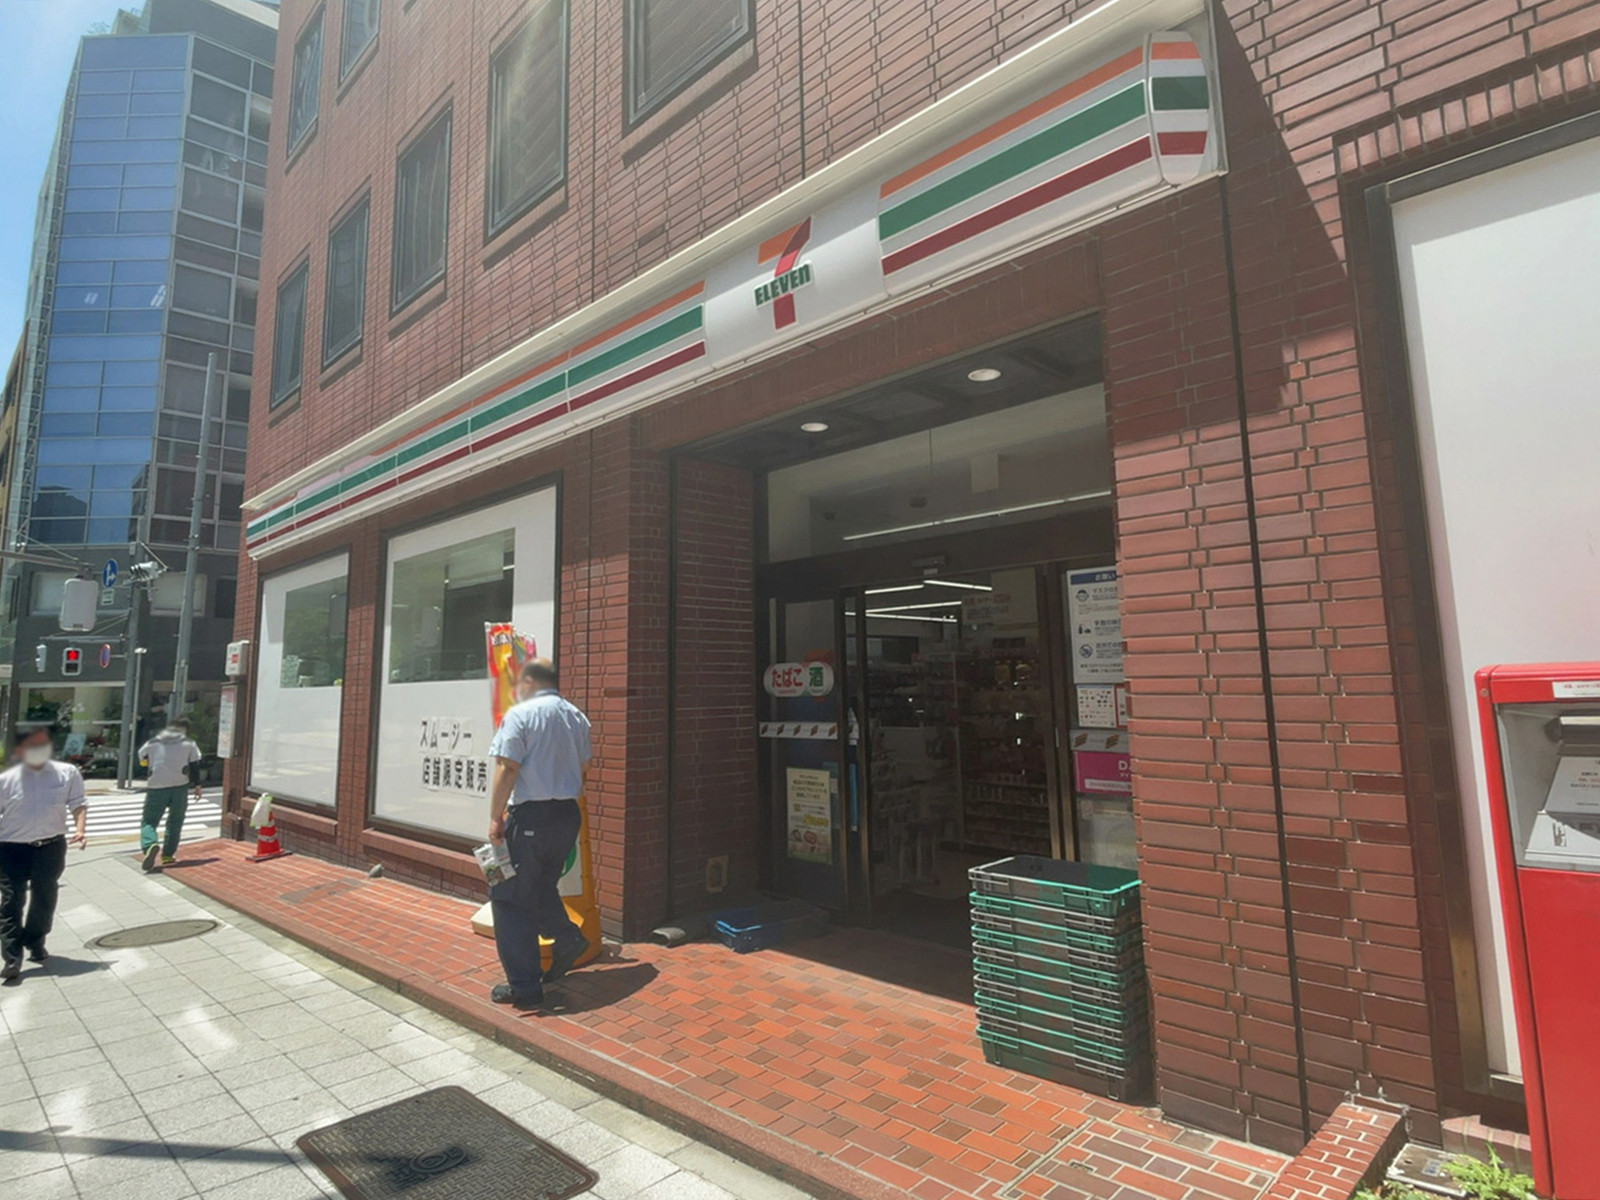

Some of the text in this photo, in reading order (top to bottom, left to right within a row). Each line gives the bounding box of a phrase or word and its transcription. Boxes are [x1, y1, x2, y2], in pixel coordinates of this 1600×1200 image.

[757, 216, 812, 330] 7
[771, 666, 824, 688] たばこ 酒
[420, 720, 472, 750] スムージー
[422, 756, 487, 792] 店舗限定販売
